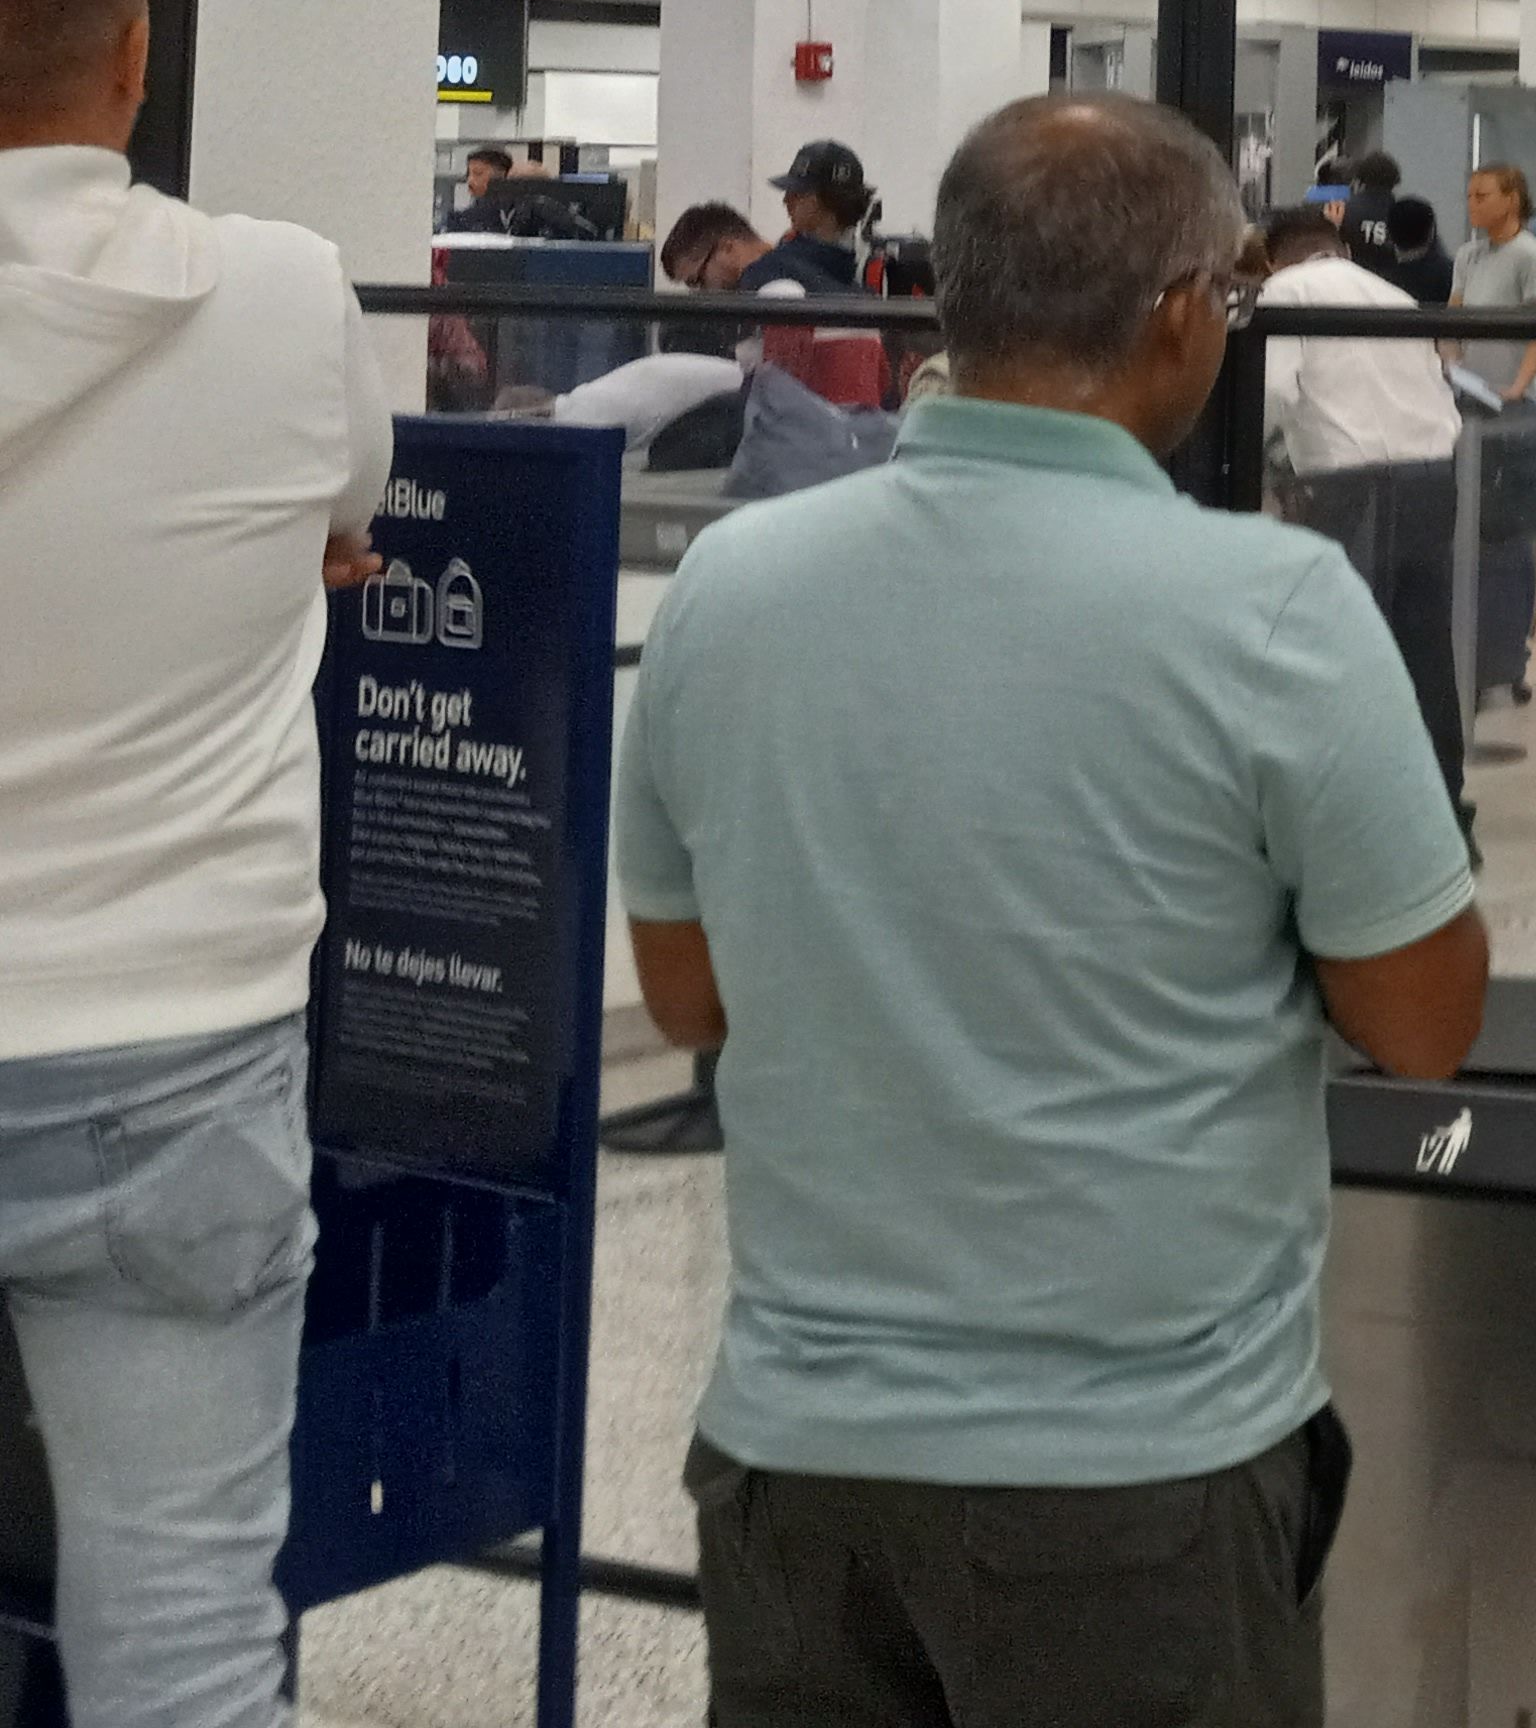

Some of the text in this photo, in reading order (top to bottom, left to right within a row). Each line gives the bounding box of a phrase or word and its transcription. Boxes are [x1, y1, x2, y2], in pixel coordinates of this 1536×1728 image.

[357, 673, 472, 734] Don't get
[354, 724, 526, 788] carried away.
[344, 936, 371, 971] No
